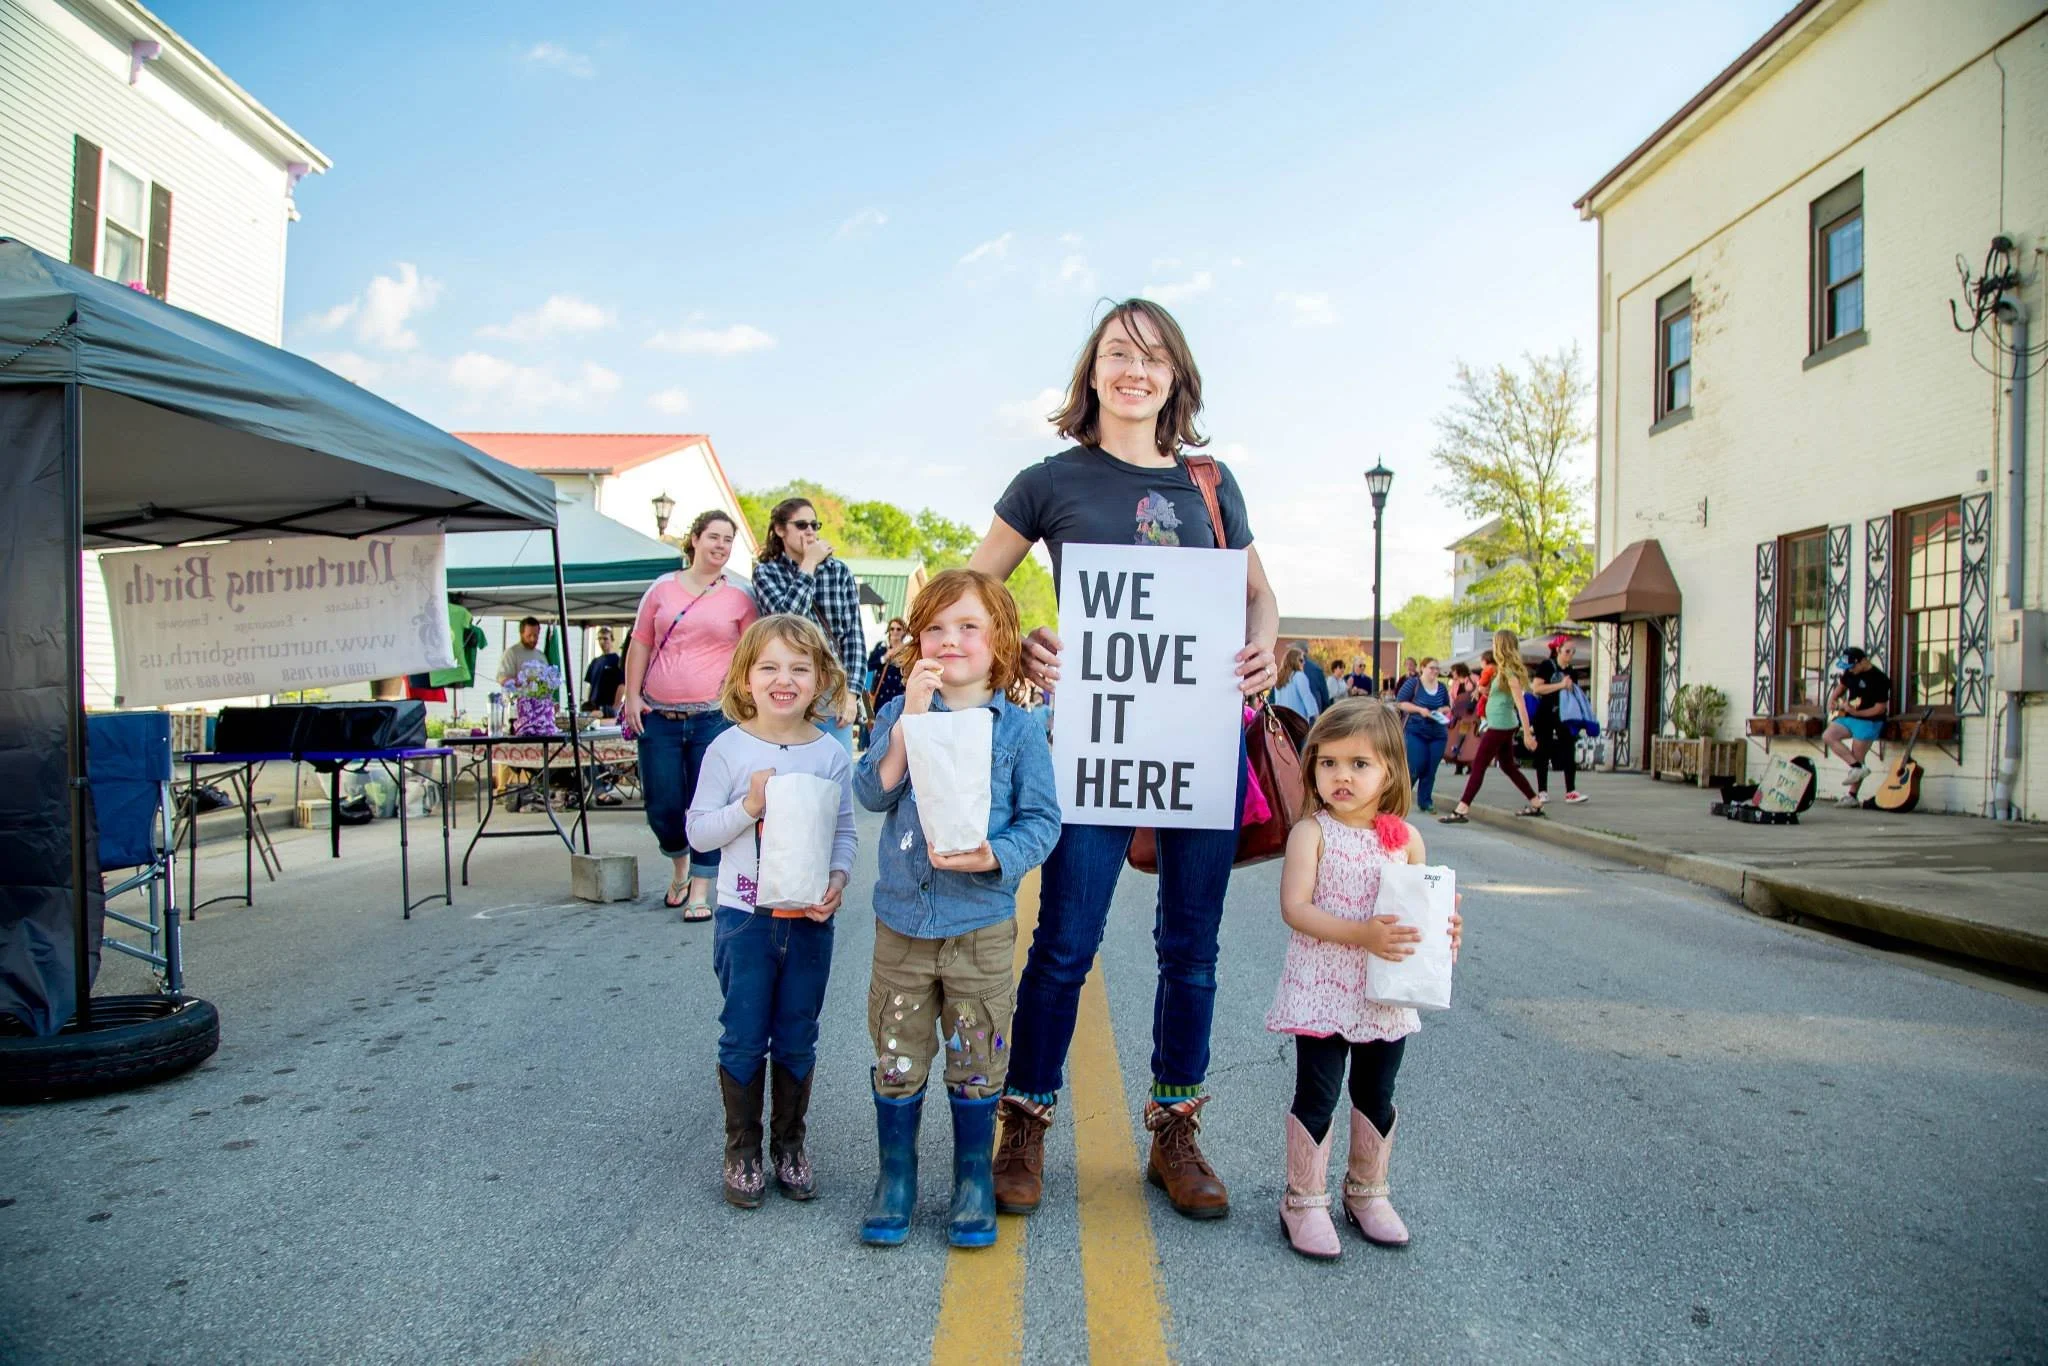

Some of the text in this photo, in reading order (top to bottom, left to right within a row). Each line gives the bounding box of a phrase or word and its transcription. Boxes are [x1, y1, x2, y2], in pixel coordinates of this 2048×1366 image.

[1079, 571, 1154, 620] WE
[1082, 632, 1196, 684] LOVE
[1091, 694, 1134, 743] IT
[1076, 758, 1194, 811] HERE
